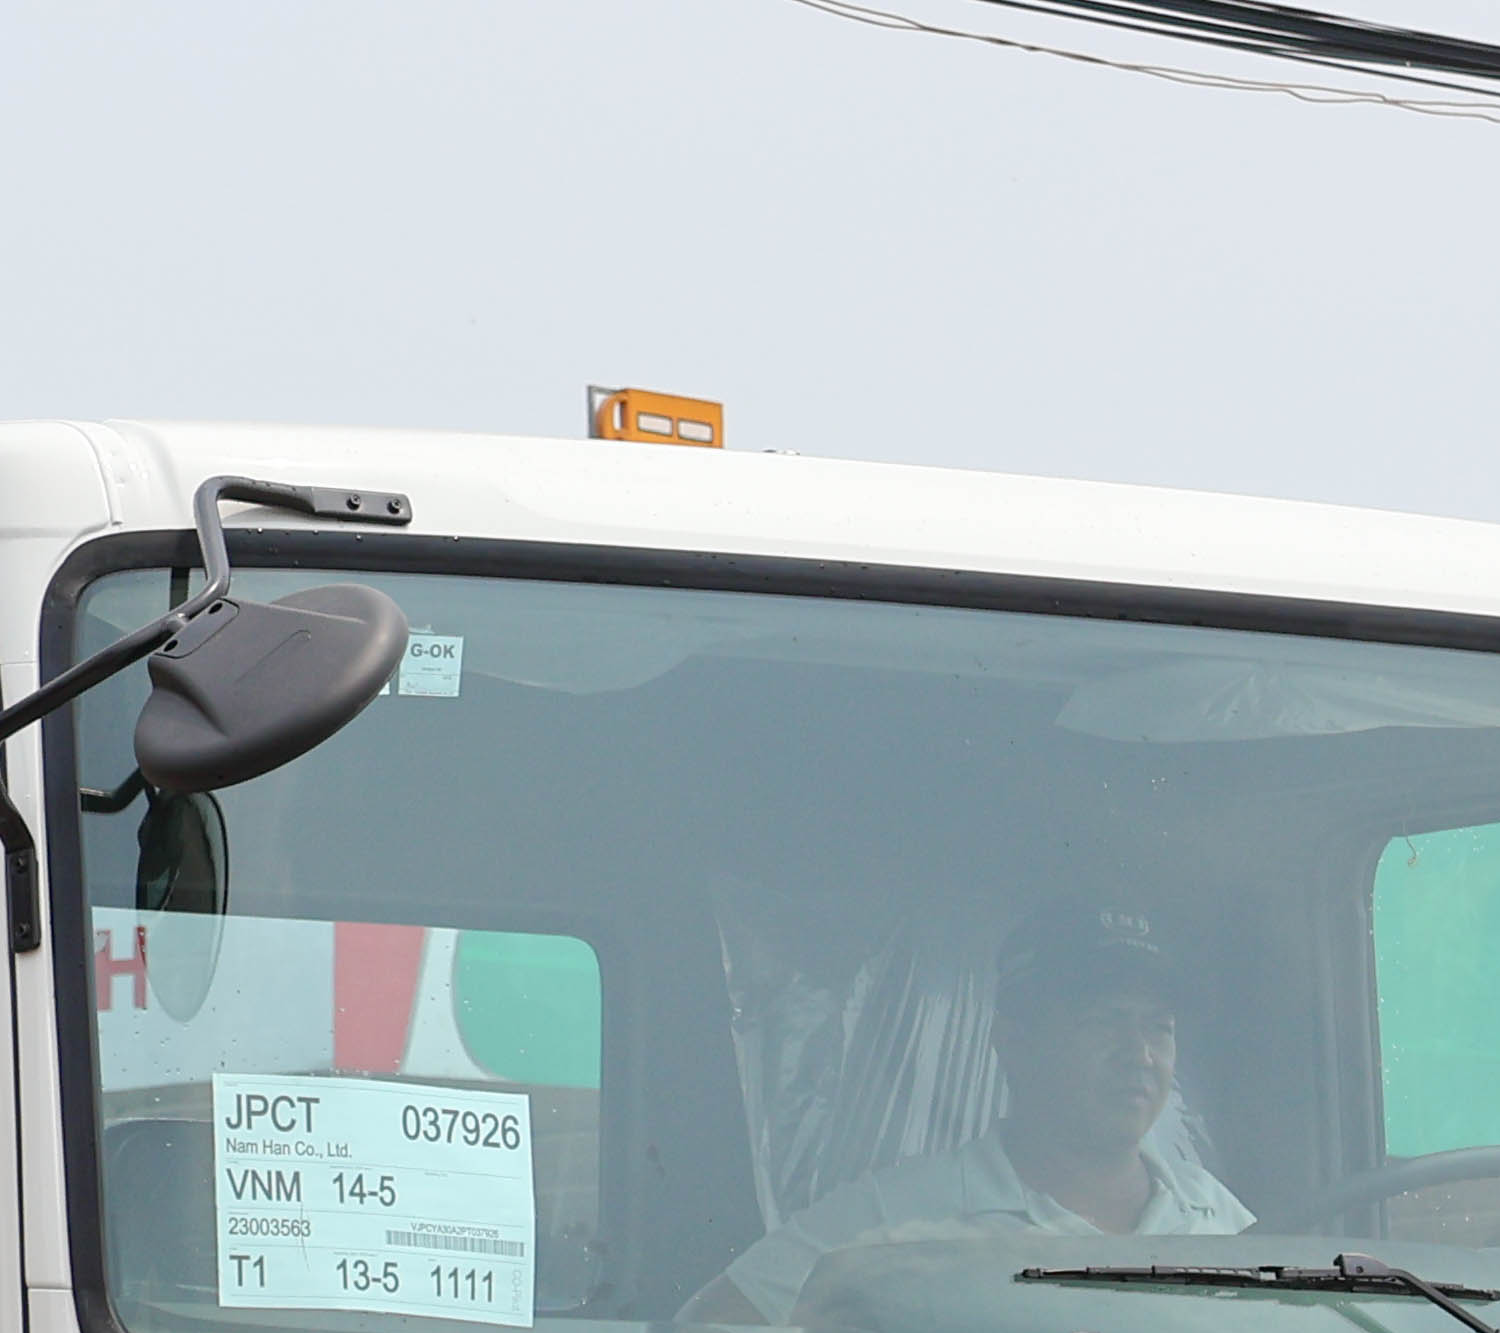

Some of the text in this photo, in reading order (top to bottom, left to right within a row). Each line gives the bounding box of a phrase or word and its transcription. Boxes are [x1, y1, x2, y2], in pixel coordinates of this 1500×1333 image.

[410, 643, 455, 659] G-OK
[225, 1093, 521, 1150] JPCT 037926
[226, 1138, 353, 1160] Nam Han Co., Ltd.
[226, 1168, 397, 1207] VNM 14-5
[228, 1217, 312, 1238] 23003563
[229, 1254, 266, 1288] T1
[336, 1258, 400, 1293] 13-5
[429, 1264, 494, 1303] 1111
